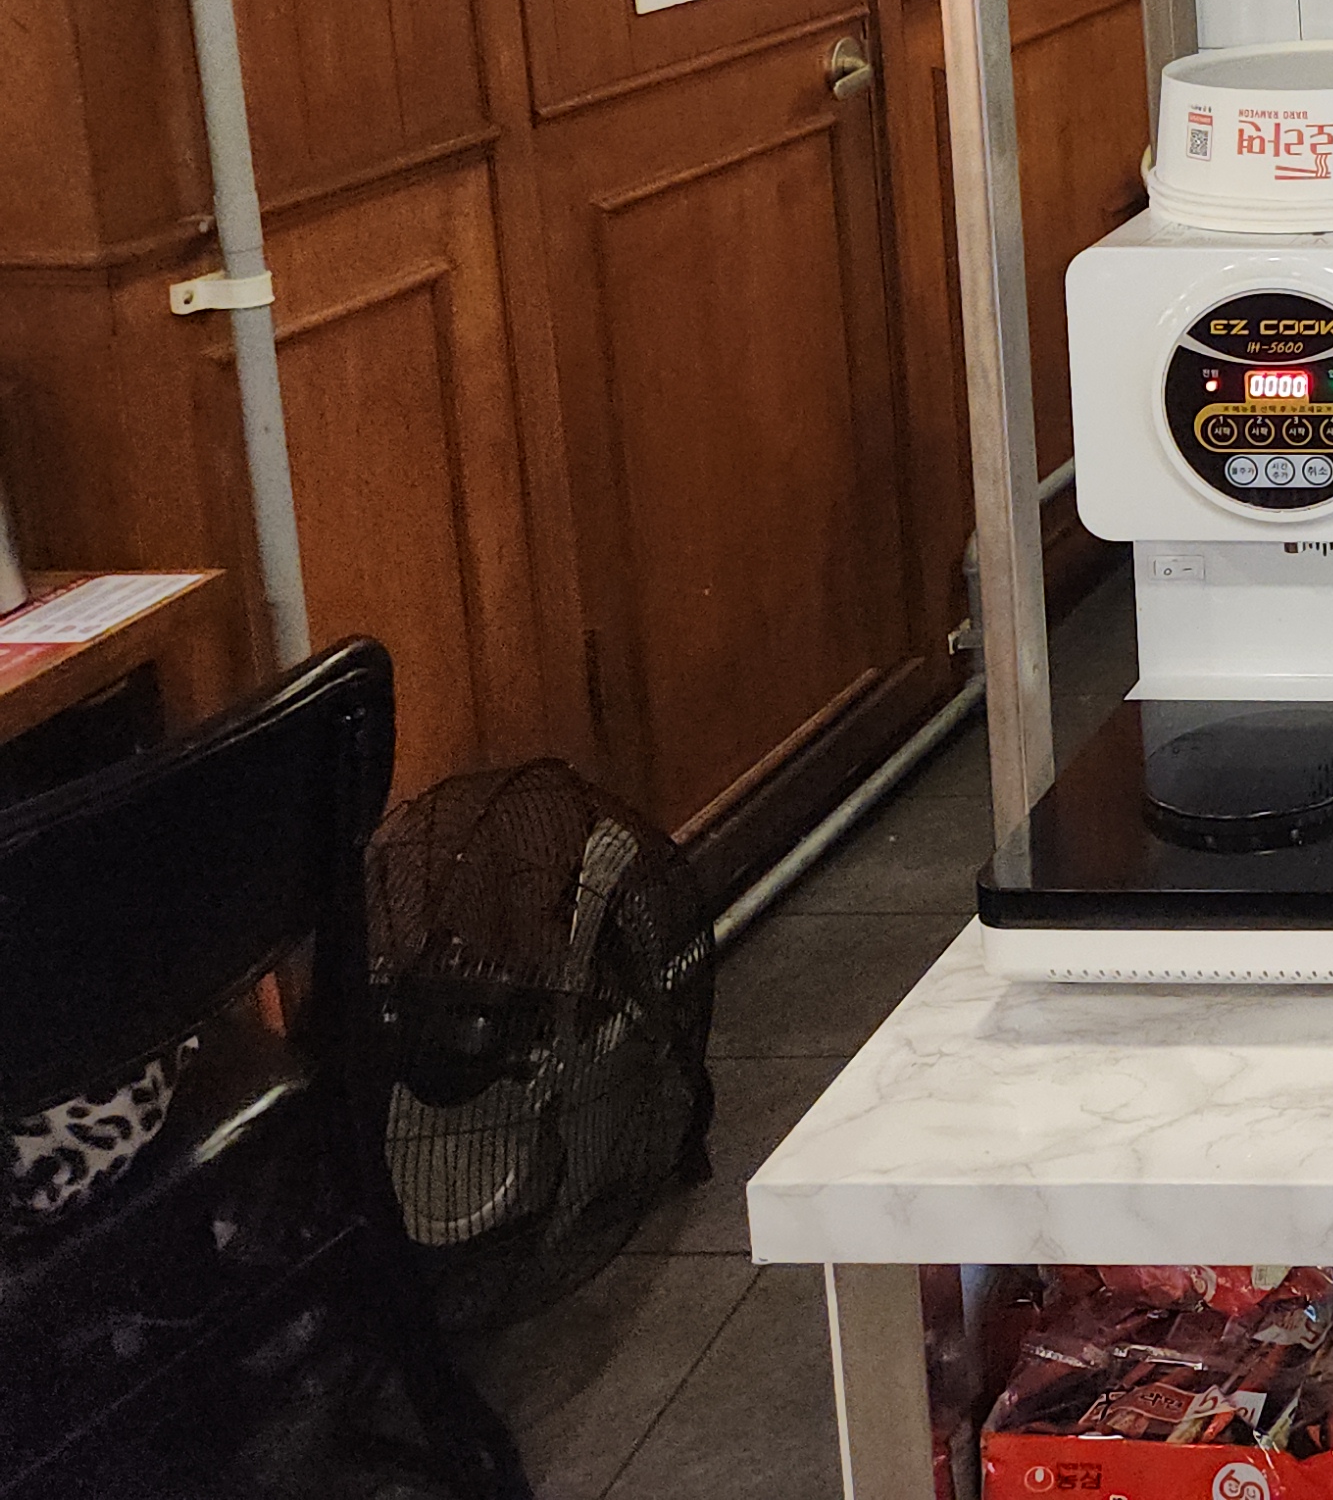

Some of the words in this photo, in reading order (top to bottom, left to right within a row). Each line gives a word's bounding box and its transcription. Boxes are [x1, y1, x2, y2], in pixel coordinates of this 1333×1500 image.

[1238, 109, 1279, 120] RAMYEON
[1283, 110, 1308, 120] BARO
[1210, 319, 1249, 335] EZ
[1246, 341, 1304, 354] IH-5600
[1250, 375, 1307, 397] 0000
